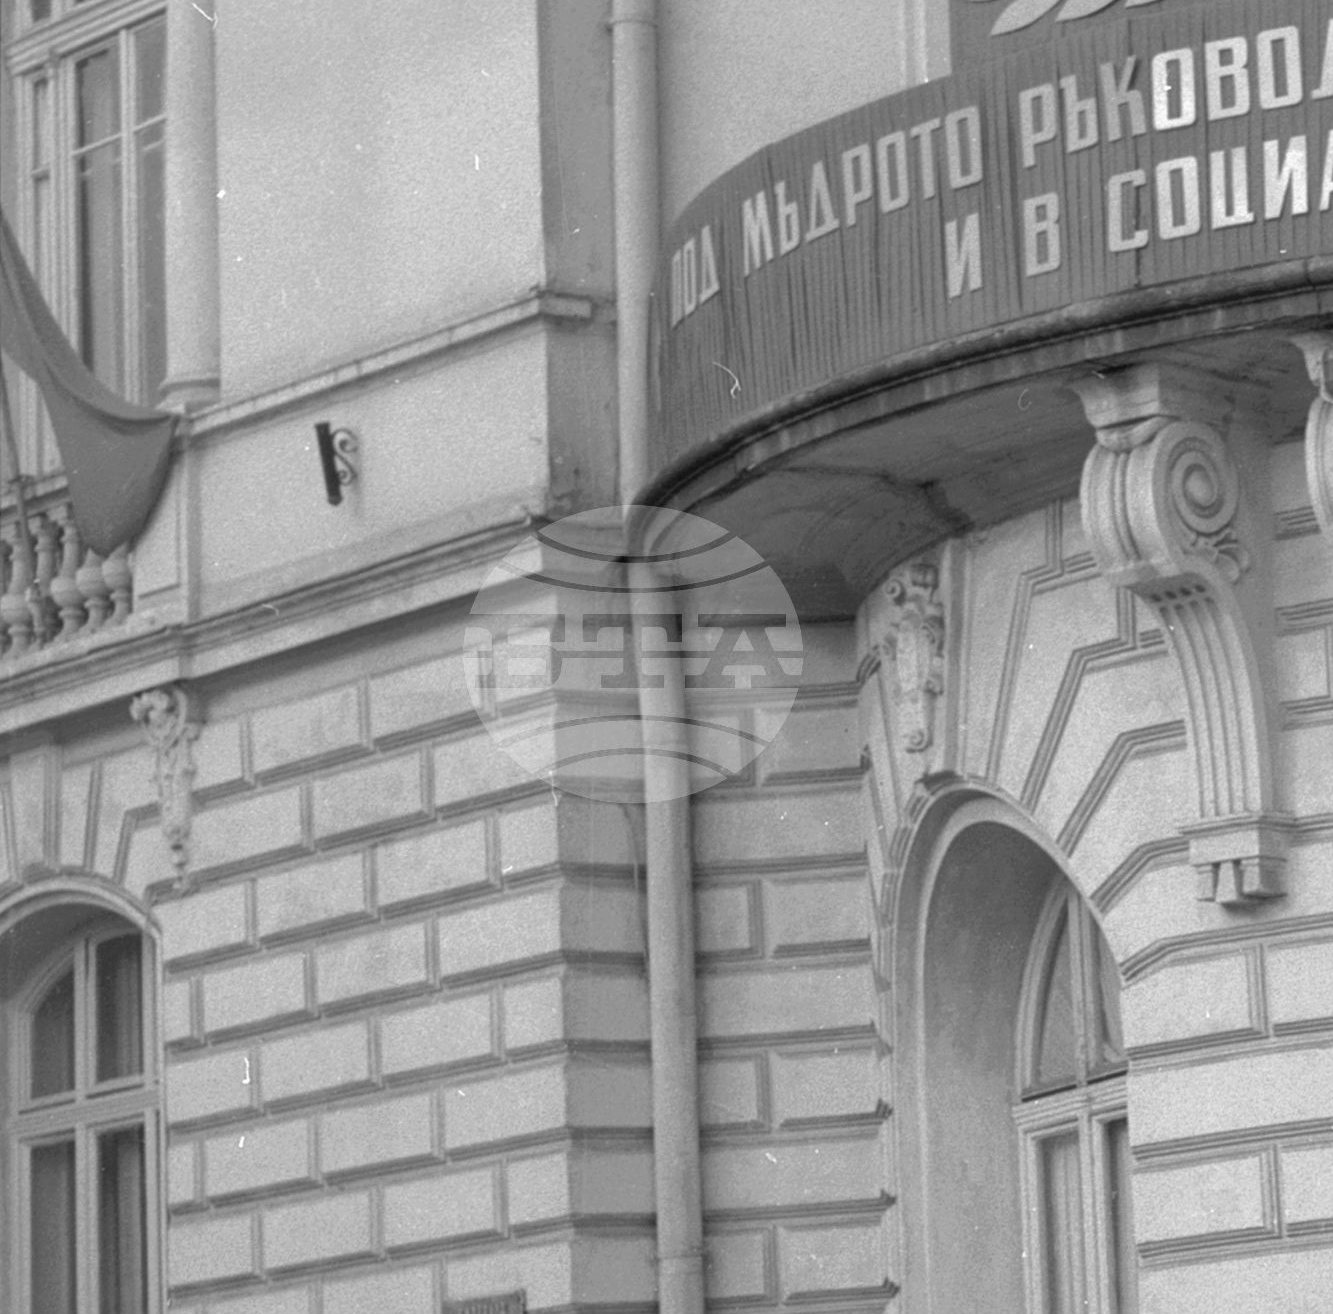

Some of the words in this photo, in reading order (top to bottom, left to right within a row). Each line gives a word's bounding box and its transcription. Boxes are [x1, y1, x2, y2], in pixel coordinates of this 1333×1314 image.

[742, 106, 983, 278] МЪДРОТО
[945, 212, 984, 300] И
[1023, 192, 1062, 277] В
